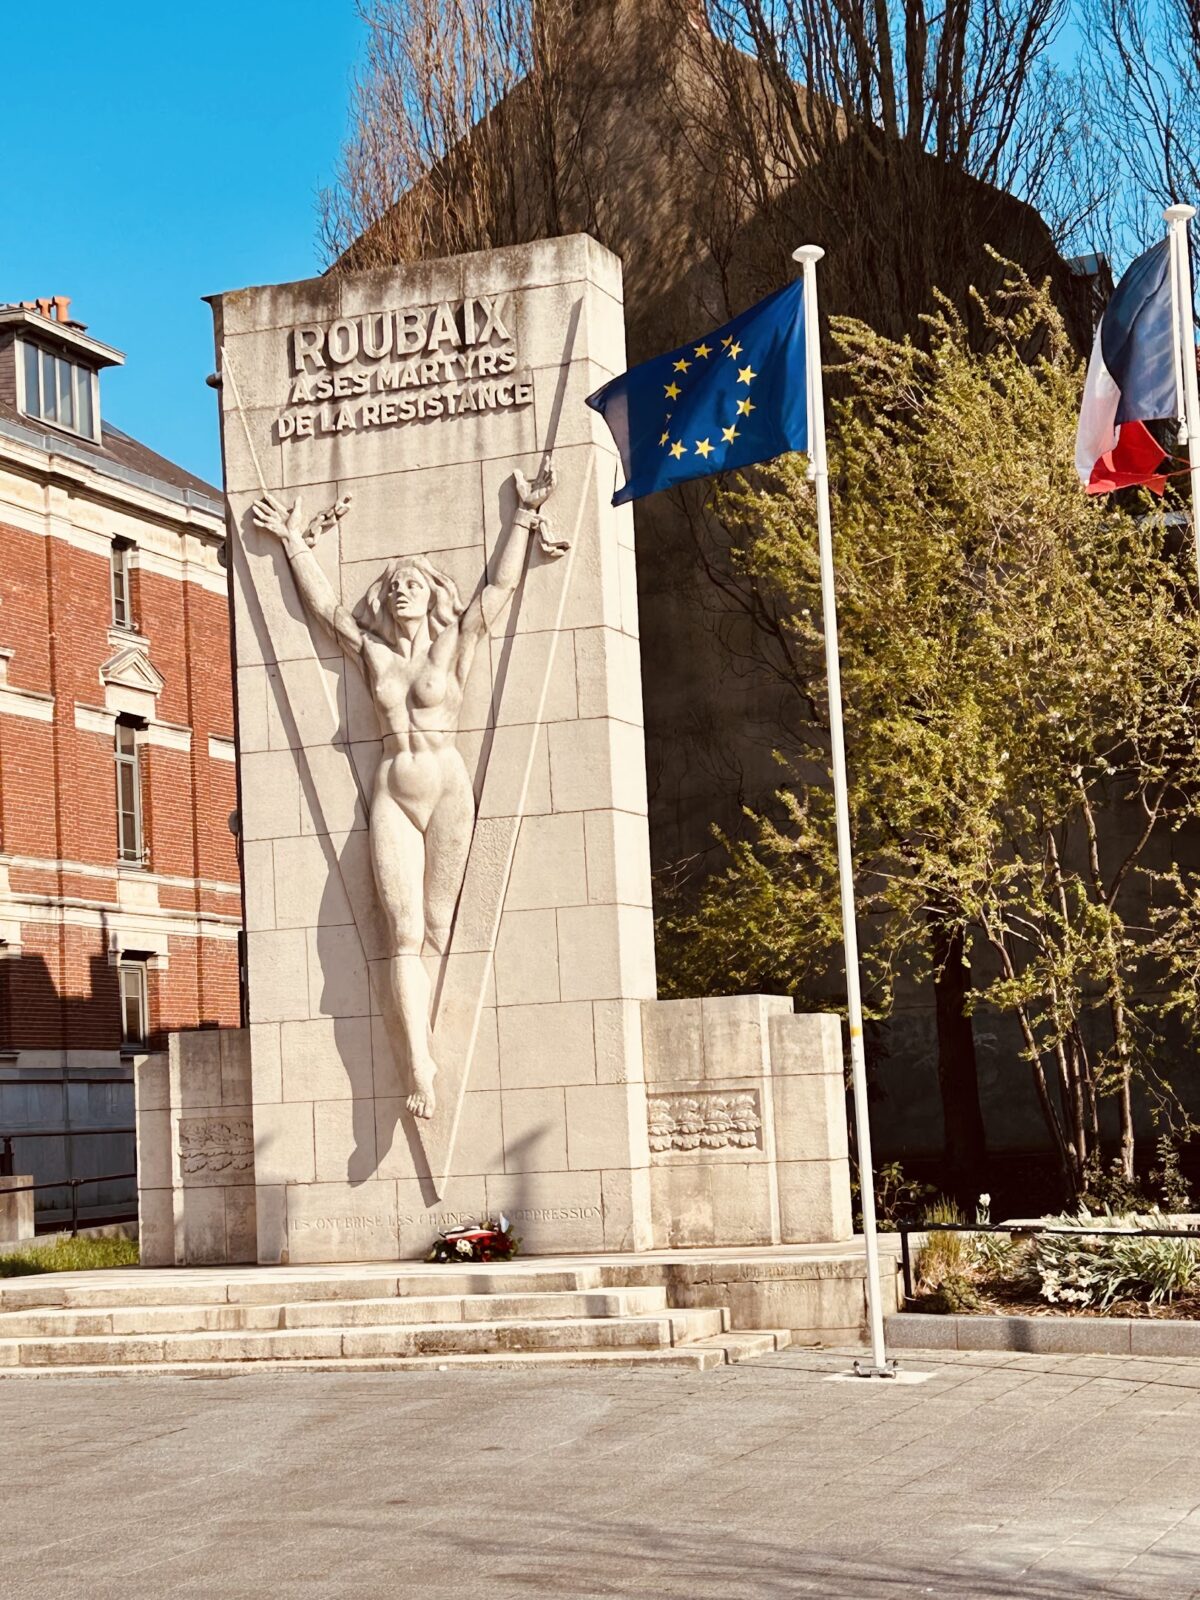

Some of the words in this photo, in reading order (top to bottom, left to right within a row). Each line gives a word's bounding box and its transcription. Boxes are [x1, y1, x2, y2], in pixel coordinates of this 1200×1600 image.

[292, 295, 512, 371] ROUBAIX
[291, 375, 316, 403] A
[316, 370, 369, 400] SES
[376, 349, 517, 391] MARTYRS
[276, 414, 314, 439] DE
[320, 405, 357, 432] LA
[362, 380, 534, 426] RESISTANCE
[316, 1215, 340, 1229] ONT
[345, 1214, 383, 1229] BRISE
[388, 1213, 413, 1227] LES
